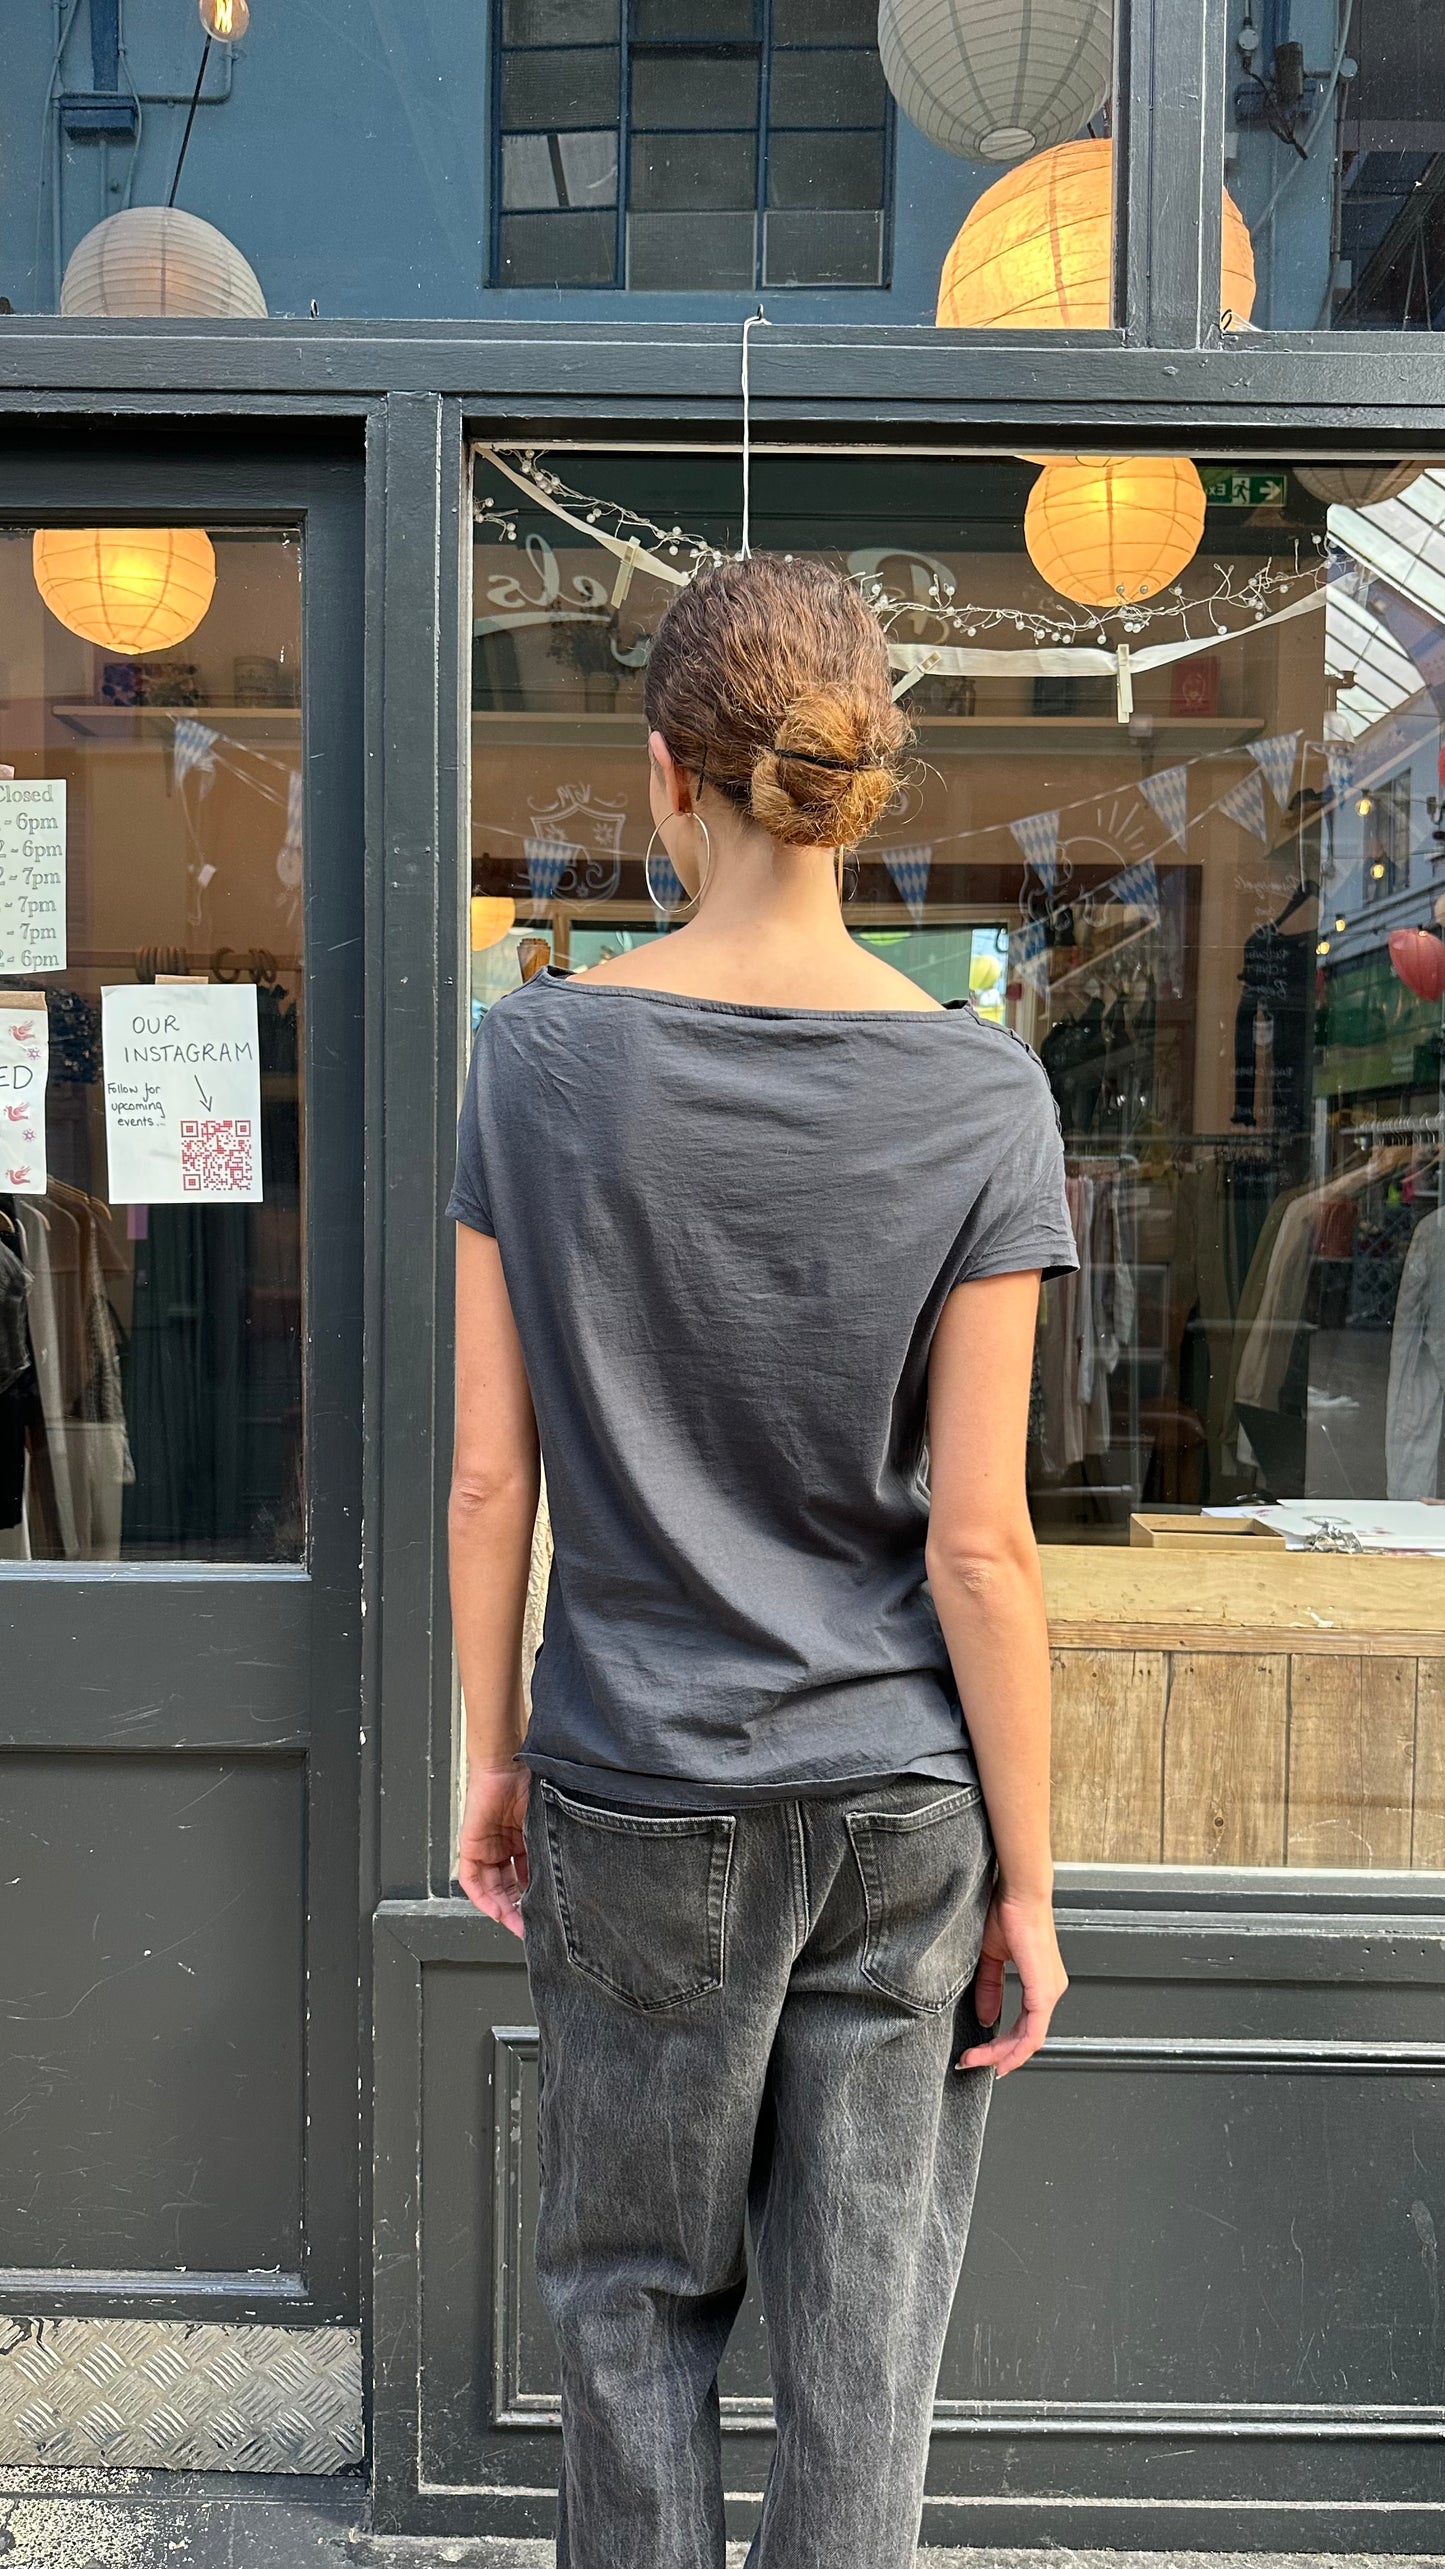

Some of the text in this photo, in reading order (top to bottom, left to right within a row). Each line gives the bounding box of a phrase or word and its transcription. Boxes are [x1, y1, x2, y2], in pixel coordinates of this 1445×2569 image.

[16, 812, 58, 835] 6pm
[22, 839, 63, 862] 6pm
[22, 867, 61, 890] 7pm
[18, 896, 57, 918] 7pm
[20, 923, 57, 945] 7pm
[21, 949, 60, 972] 6pm
[132, 1014, 180, 1034] OUR
[124, 1042, 253, 1063] INSTAGRAM
[107, 1082, 161, 1103] Follow for
[111, 1101, 166, 1119] upcoming
